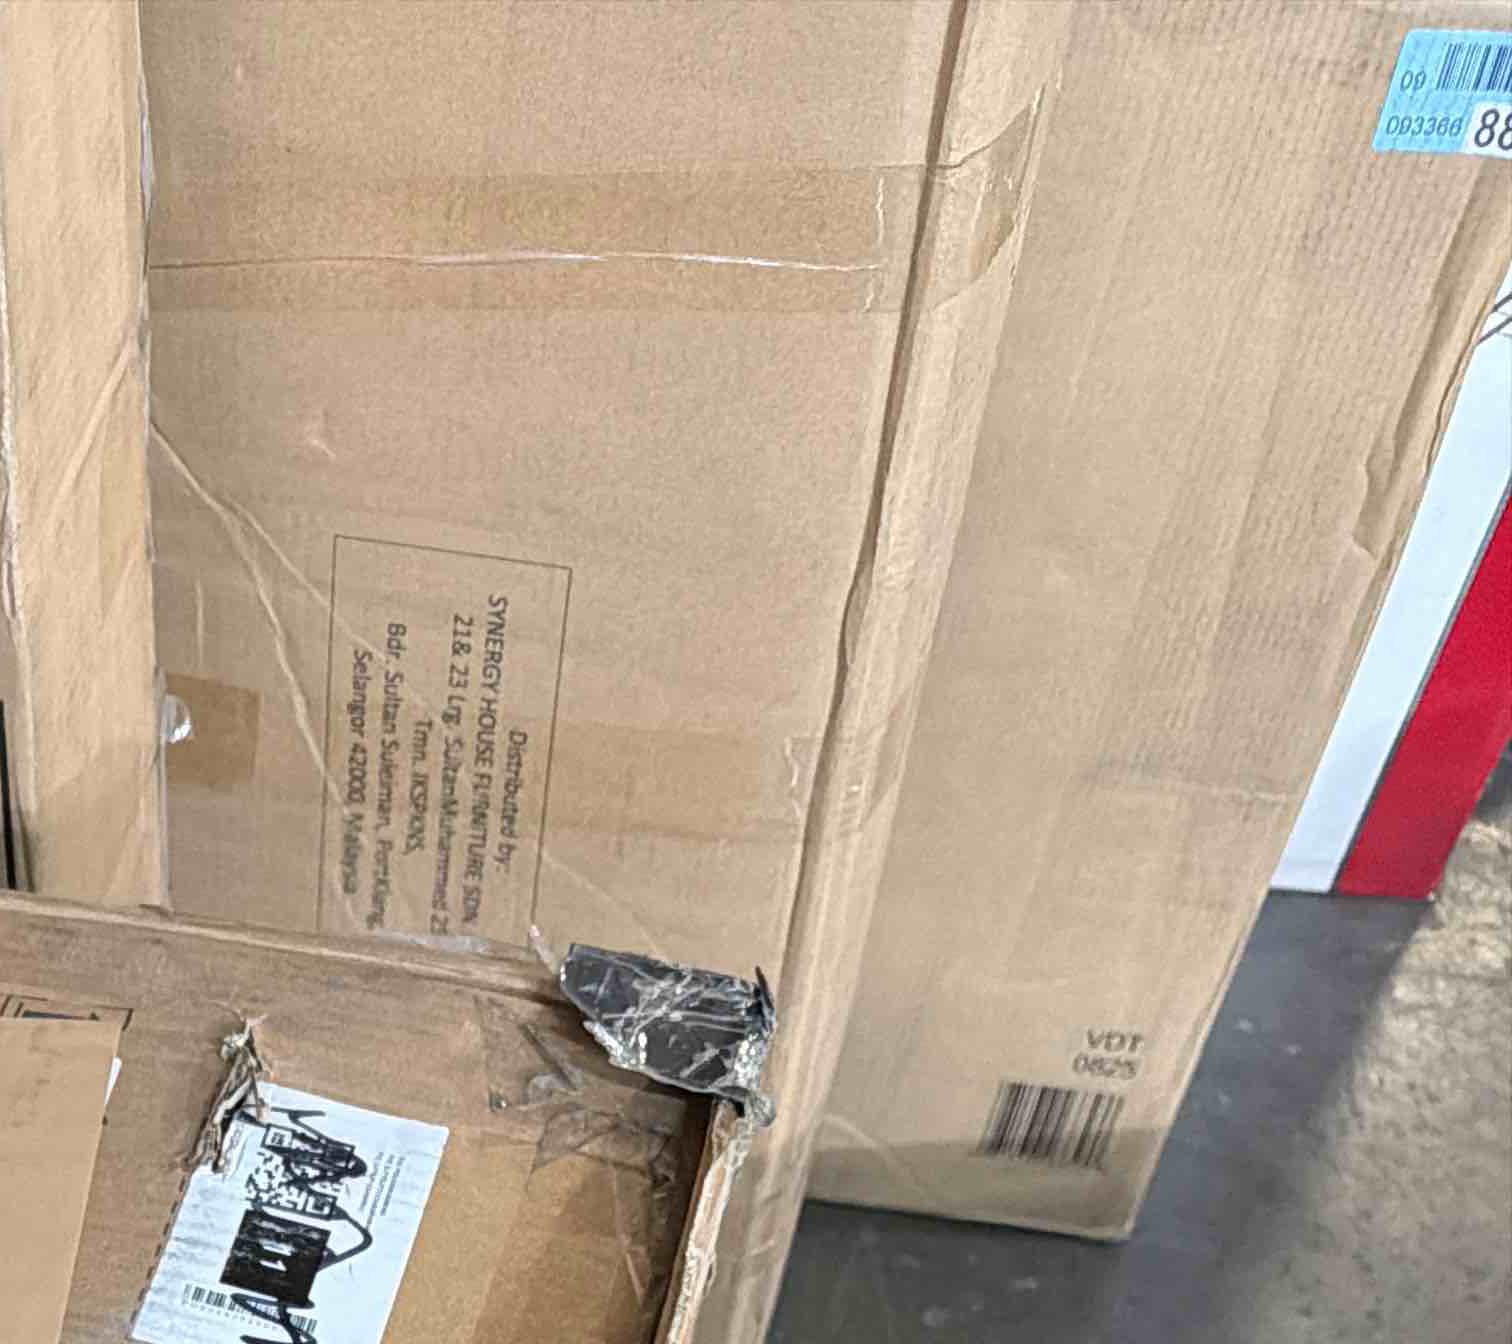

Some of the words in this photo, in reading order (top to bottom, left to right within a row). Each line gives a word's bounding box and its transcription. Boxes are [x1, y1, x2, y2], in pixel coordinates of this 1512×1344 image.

[1400, 69, 1427, 91] 09
[480, 593, 509, 693] SYNERGY
[345, 648, 373, 738] Selangor
[381, 669, 405, 729] Sultan
[474, 697, 498, 771] HOUSE
[500, 729, 529, 839] Distributed
